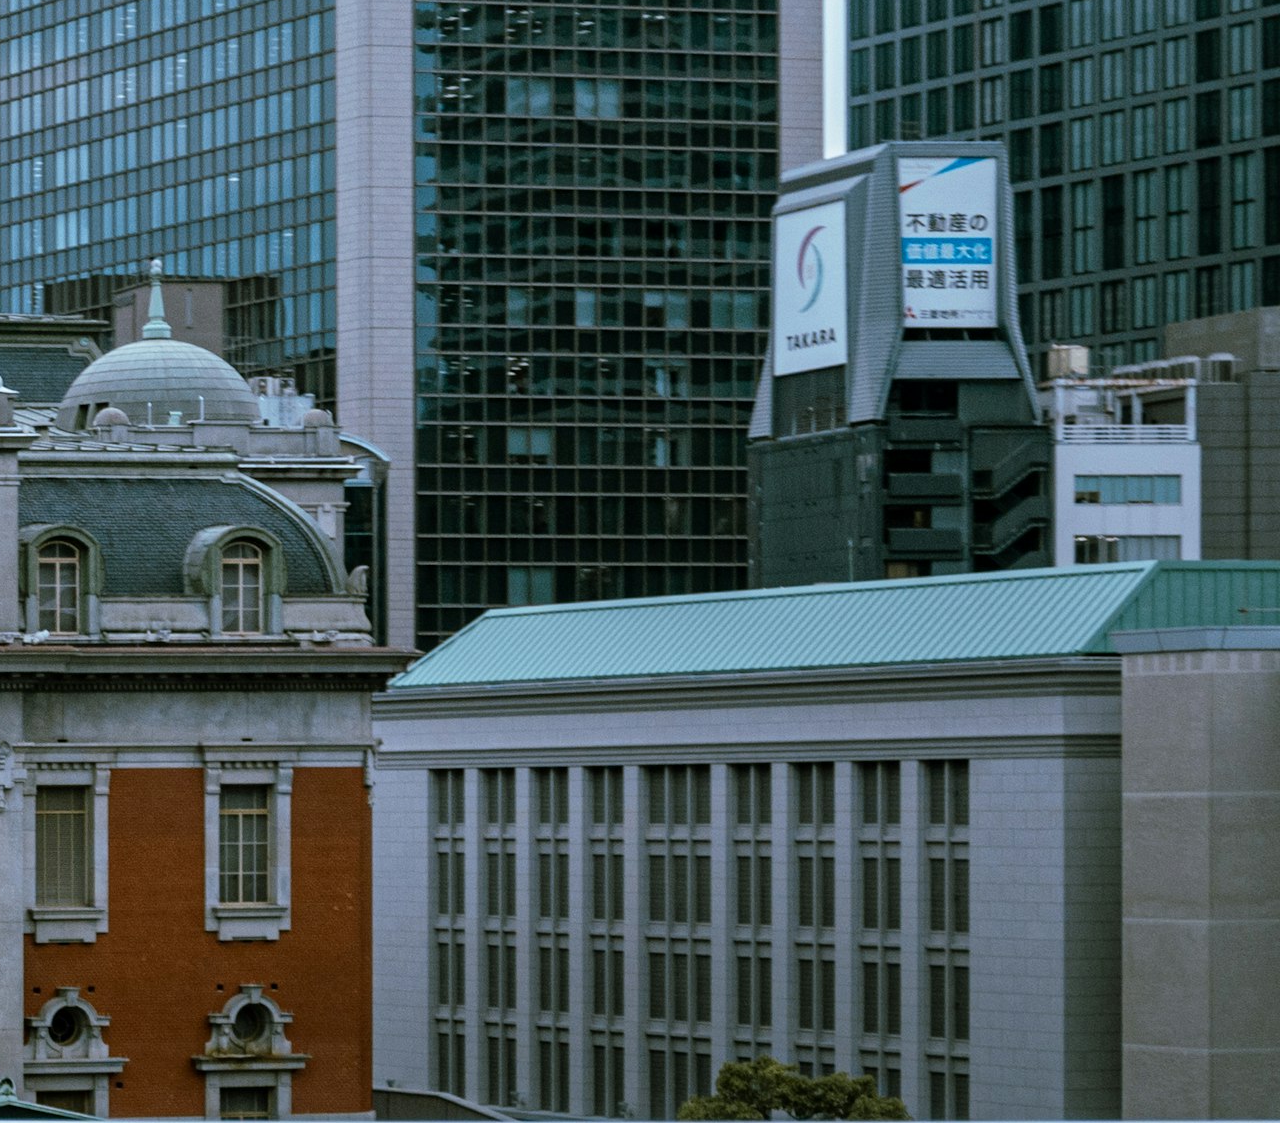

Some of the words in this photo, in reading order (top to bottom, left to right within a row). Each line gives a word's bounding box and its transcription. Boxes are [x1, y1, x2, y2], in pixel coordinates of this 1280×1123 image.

[905, 212, 989, 233] 不動産の
[905, 242, 989, 260] 価値最大化
[905, 269, 990, 290] 最適活用
[785, 327, 838, 352] TAKARA
